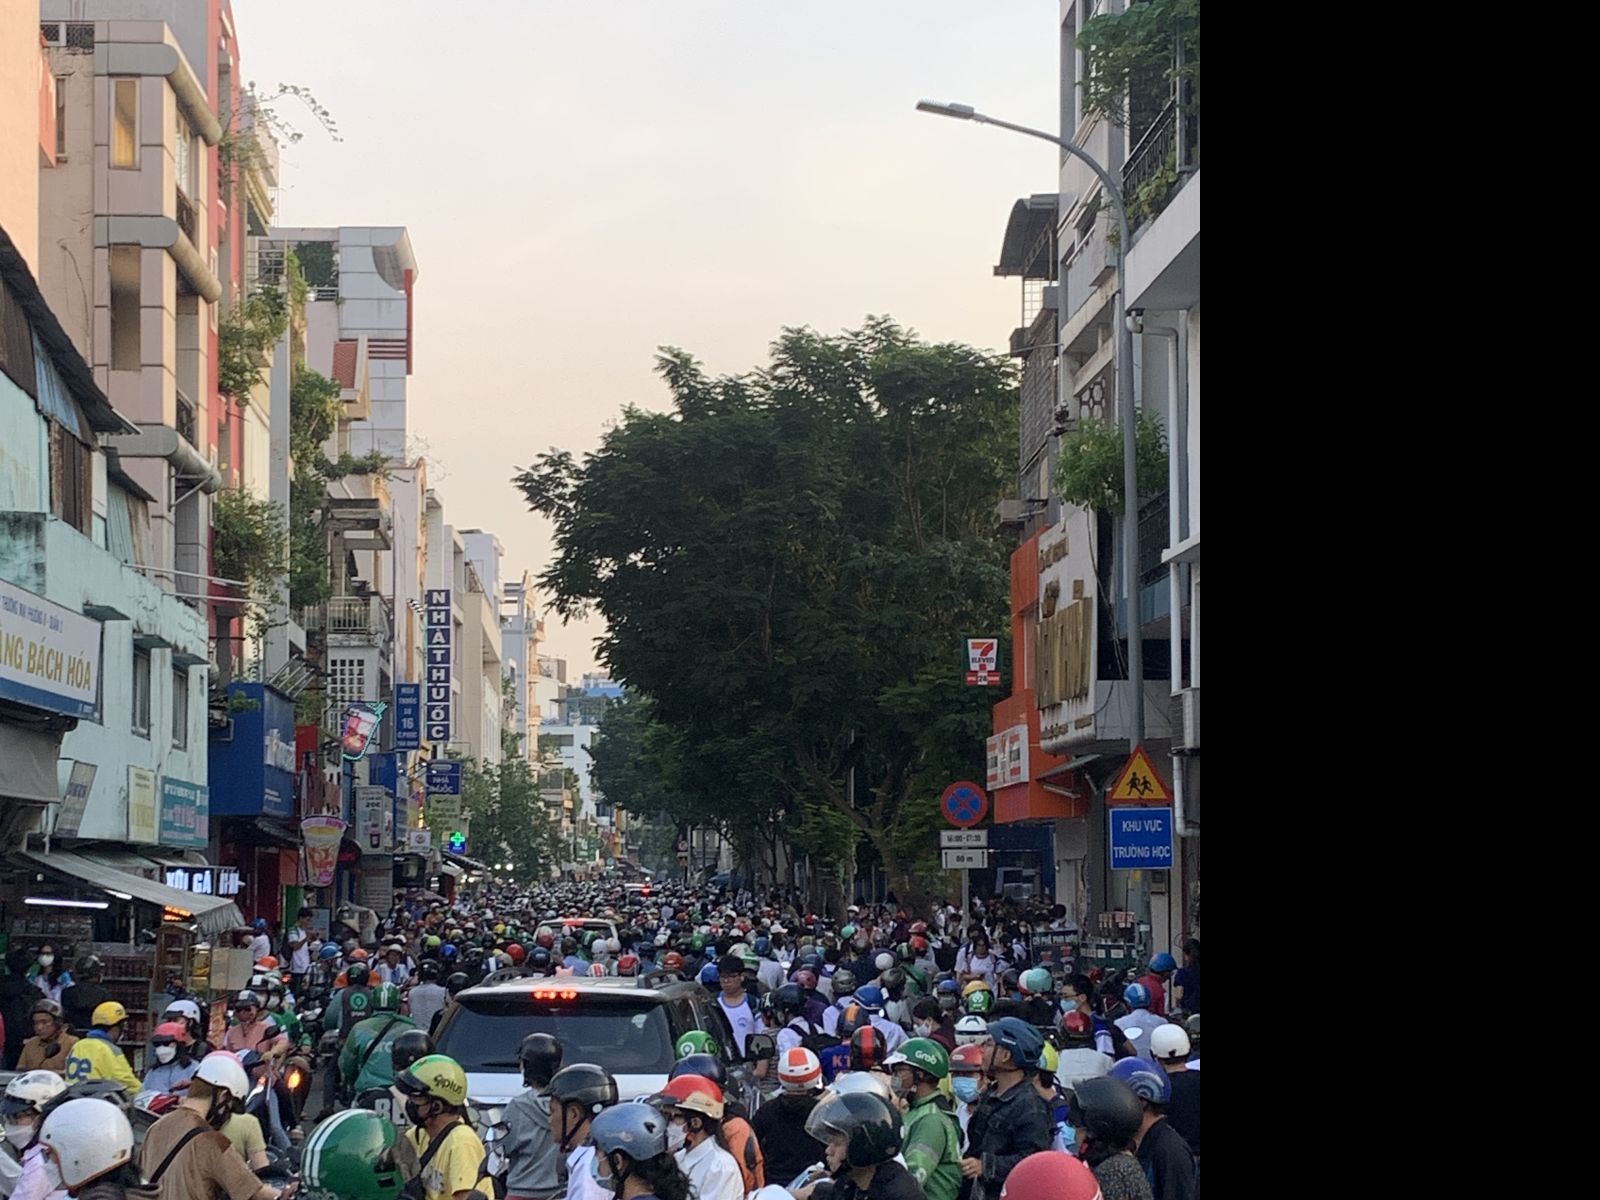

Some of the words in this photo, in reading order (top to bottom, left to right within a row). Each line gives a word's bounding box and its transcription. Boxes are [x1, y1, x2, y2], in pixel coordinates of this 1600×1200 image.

[432, 592, 446, 644] NHÀ
[27, 636, 63, 683] BÁCH
[66, 649, 91, 691] HÓA
[430, 650, 446, 739] THUỐC
[1122, 820, 1142, 832] KHU
[1151, 845, 1171, 860] HỌC
[192, 870, 212, 894] GÀ
[914, 1050, 938, 1065] Grab
